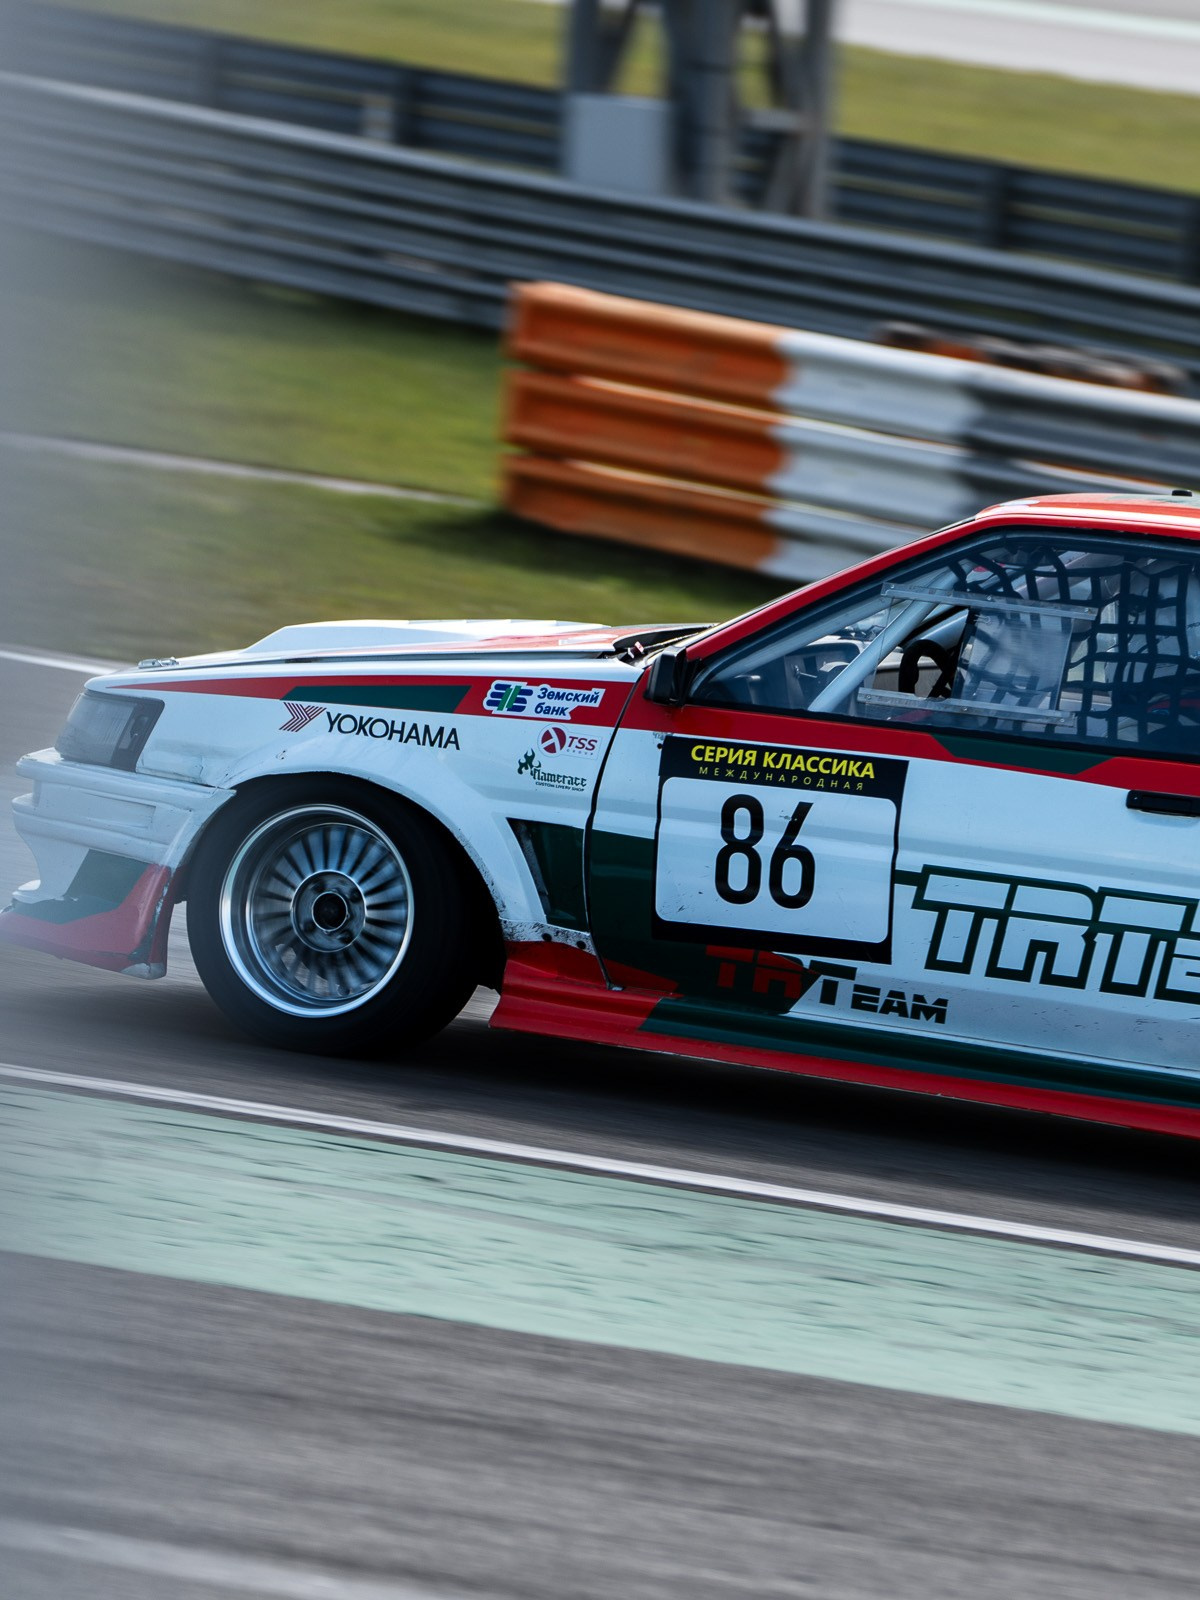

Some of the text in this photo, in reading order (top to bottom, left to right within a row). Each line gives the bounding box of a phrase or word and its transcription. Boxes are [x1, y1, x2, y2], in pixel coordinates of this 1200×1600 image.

[537, 687, 600, 704] Земский
[534, 702, 569, 717] банк
[326, 711, 460, 751] YOKOHAMA
[567, 735, 598, 751] TSS
[691, 744, 876, 779] СЕРИЯ КЛАССИКА
[698, 766, 864, 791] МЕЖДУНАРОДНАЯ
[715, 793, 815, 909] 86
